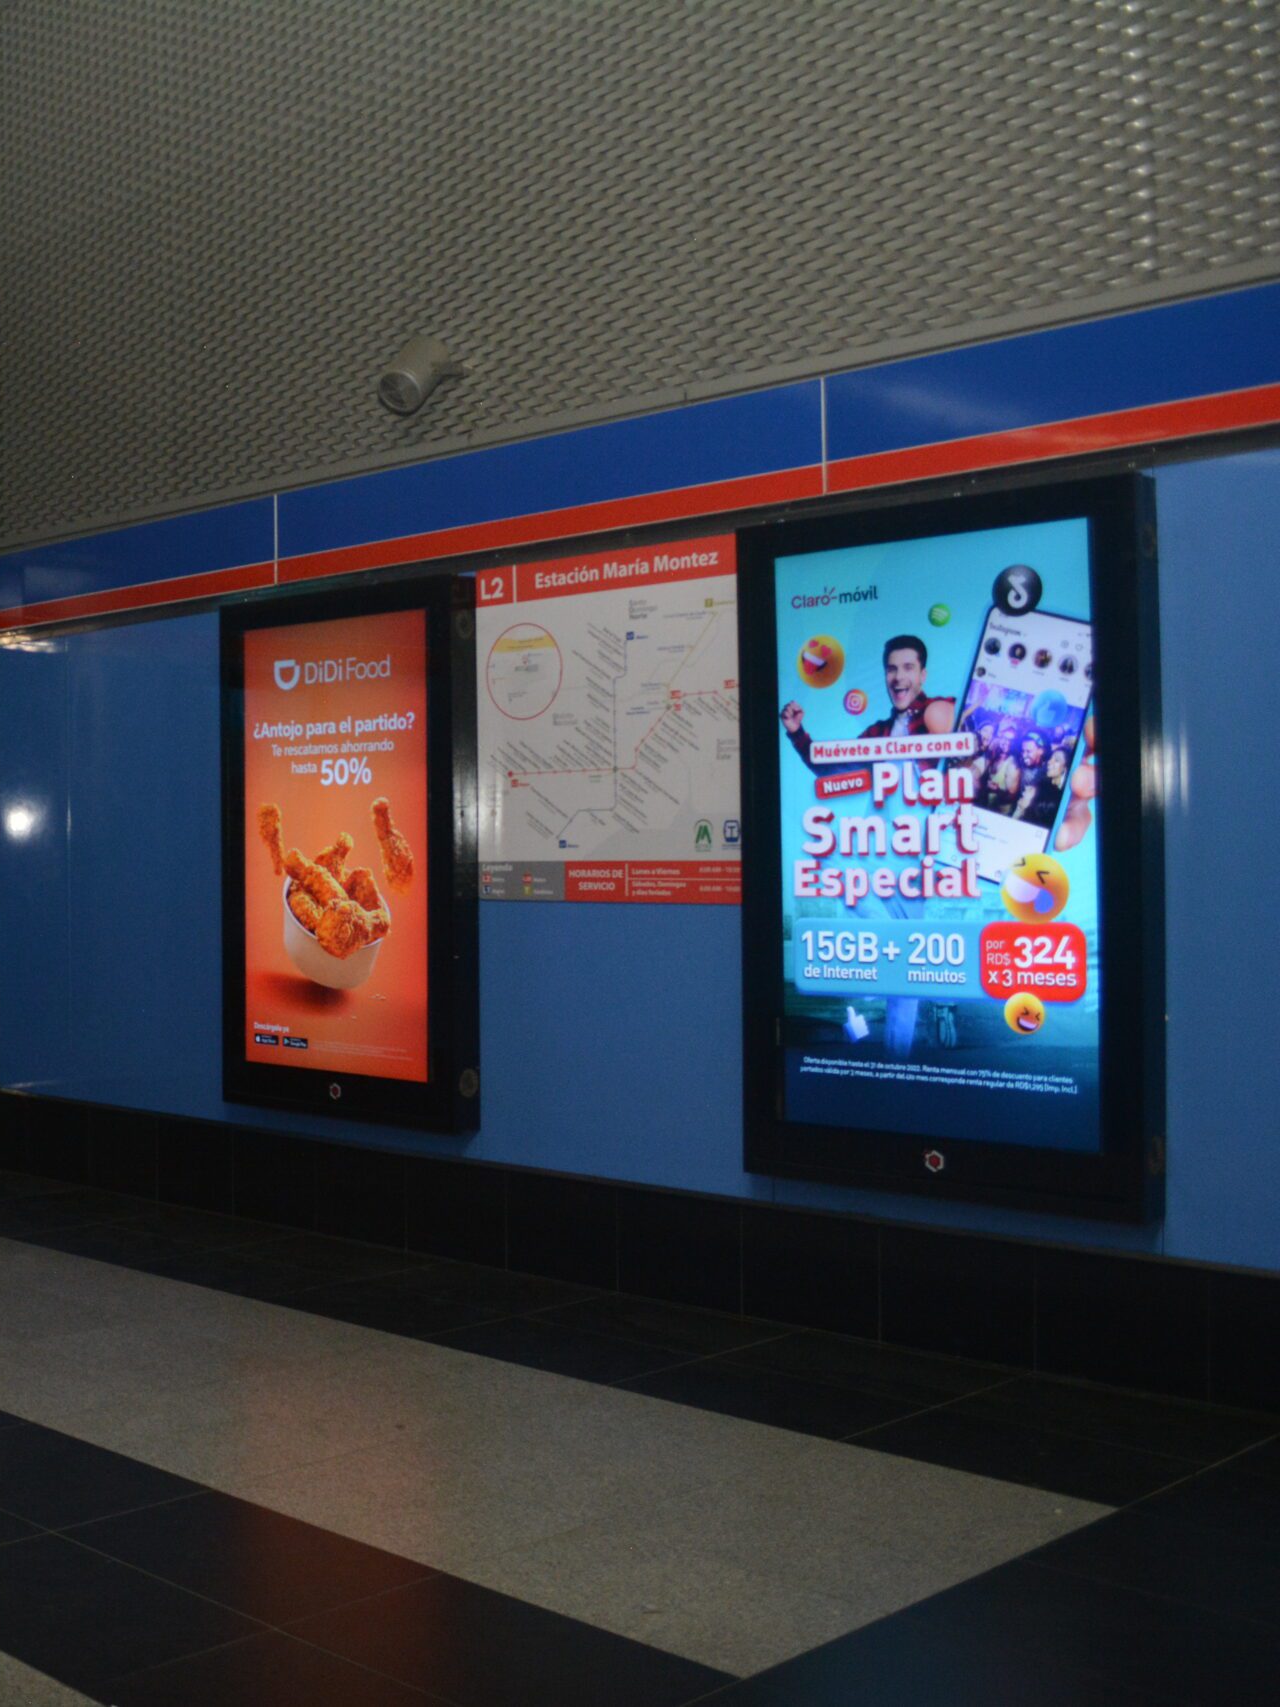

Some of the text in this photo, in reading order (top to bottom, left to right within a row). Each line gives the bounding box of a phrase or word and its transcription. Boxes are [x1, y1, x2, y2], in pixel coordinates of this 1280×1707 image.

[535, 551, 718, 589] Estación María Montez
[481, 577, 504, 600] L2
[791, 586, 878, 609] Claro móvil
[253, 710, 415, 740] ¿Antojo para el partido?
[272, 739, 394, 756] Te rescatamos ahorrando
[814, 737, 970, 759] Muévete a Claro con el
[291, 756, 372, 786] hasta 50%
[823, 762, 974, 806] Nuevo Plan
[802, 804, 979, 856] Smart
[569, 869, 624, 878] HORARIOS DE
[793, 856, 981, 906] Especial
[578, 882, 616, 891] SERVICIO
[801, 931, 878, 963] 15GB
[907, 933, 965, 965] 200
[986, 940, 1005, 952] por
[986, 936, 1076, 970] RD$ 324
[804, 965, 966, 984] de Internet minutos
[988, 969, 1077, 987] x 3 meses
